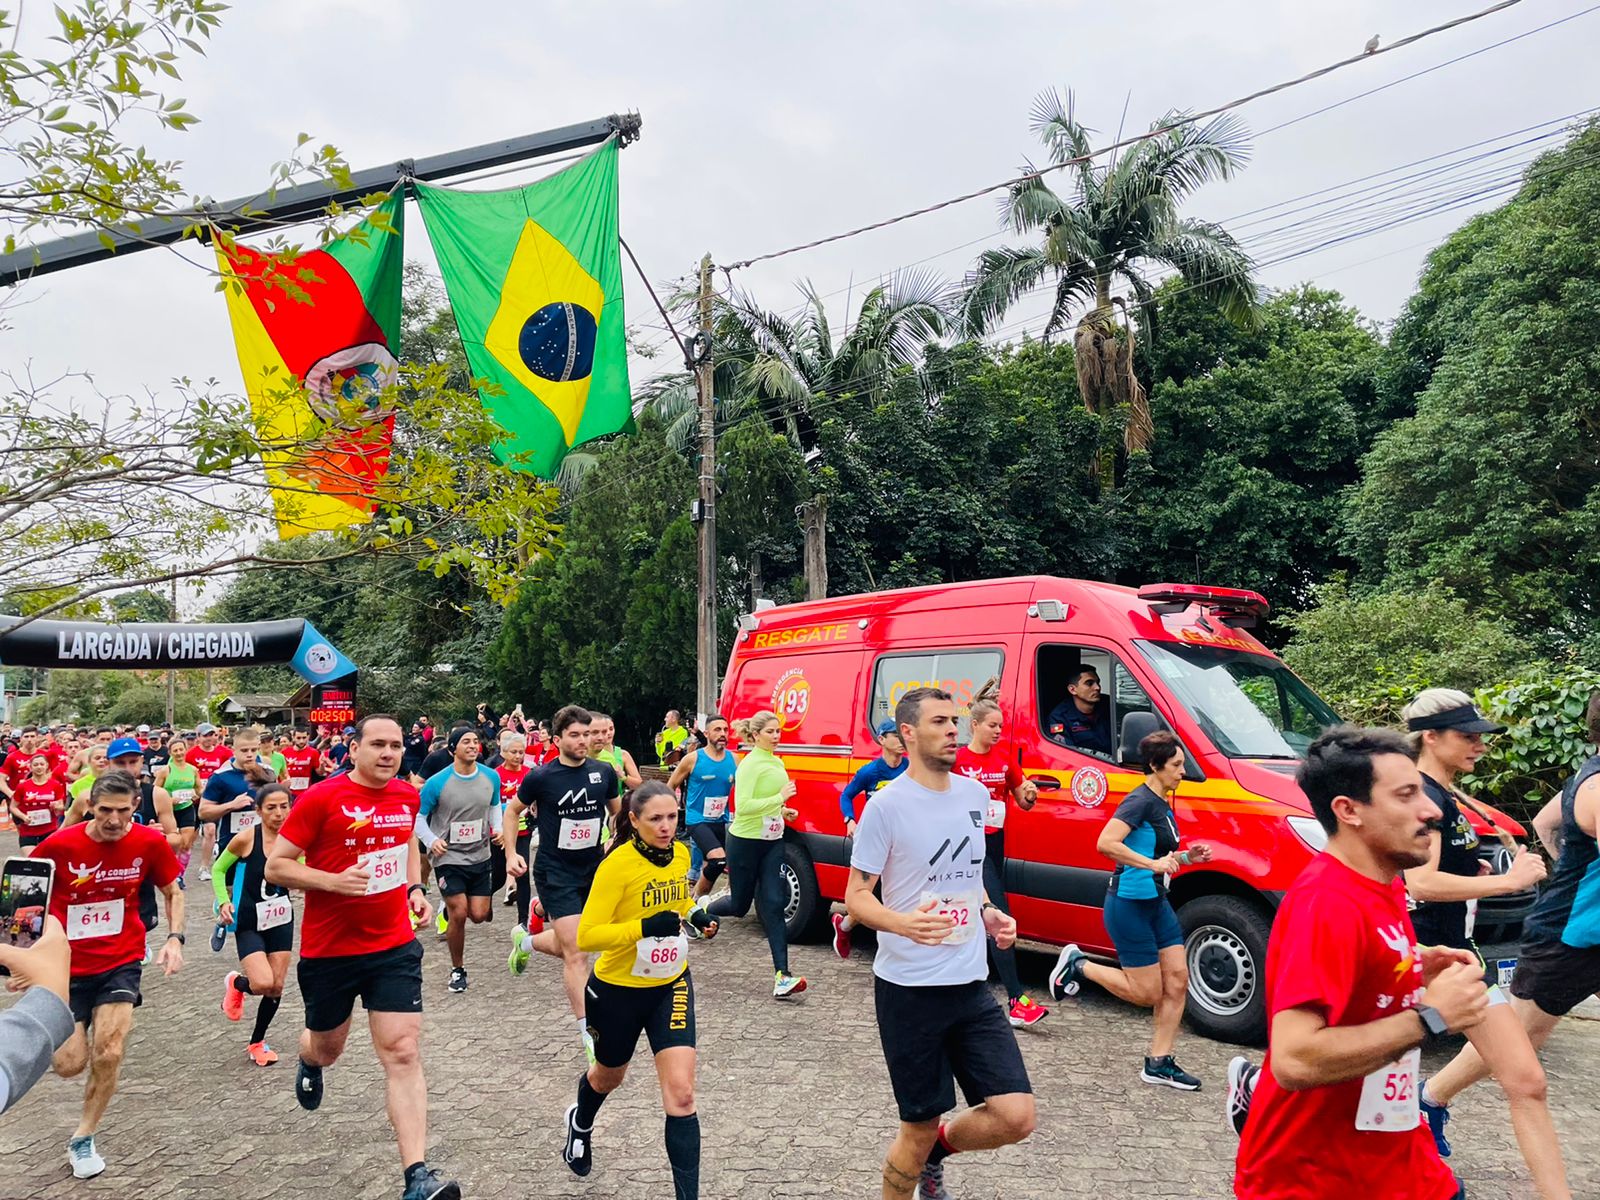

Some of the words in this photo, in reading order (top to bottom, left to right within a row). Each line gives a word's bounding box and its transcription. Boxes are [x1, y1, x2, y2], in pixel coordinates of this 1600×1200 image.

[565, 303, 576, 330] ORDEM
[754, 624, 849, 649] RESGATE
[58, 631, 152, 660] LARGADA
[167, 631, 255, 659] CHEGADA
[778, 688, 808, 713] 193
[558, 805, 598, 816] MIXRUN
[459, 827, 475, 837] 521
[570, 829, 591, 840] 536
[375, 860, 398, 879] 581
[81, 911, 111, 926] 614
[265, 906, 286, 920] 710
[939, 908, 969, 926] 32
[651, 948, 678, 964] 686
